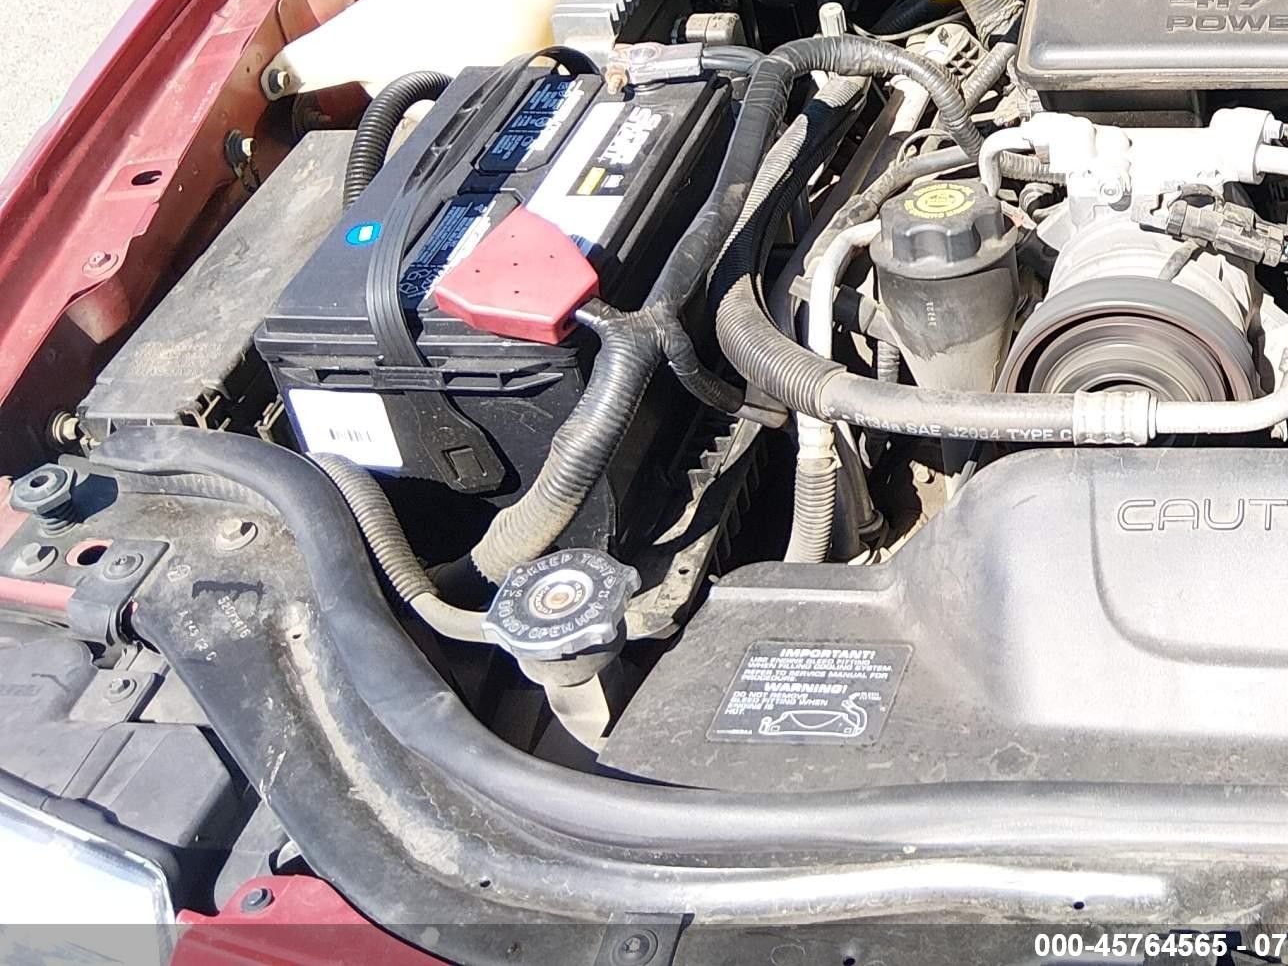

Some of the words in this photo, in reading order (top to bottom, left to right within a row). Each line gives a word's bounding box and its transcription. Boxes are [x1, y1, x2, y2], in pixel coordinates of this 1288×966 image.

[906, 422, 942, 436] SAE
[1006, 428, 1055, 441] TYPE
[527, 553, 574, 576] KEEP
[502, 589, 523, 598] TVS
[528, 621, 575, 639] OPEN
[779, 648, 876, 660] IMPORTANT!
[828, 671, 868, 679] MANUAL
[869, 672, 889, 680] FOR
[765, 682, 849, 694] WARNING!
